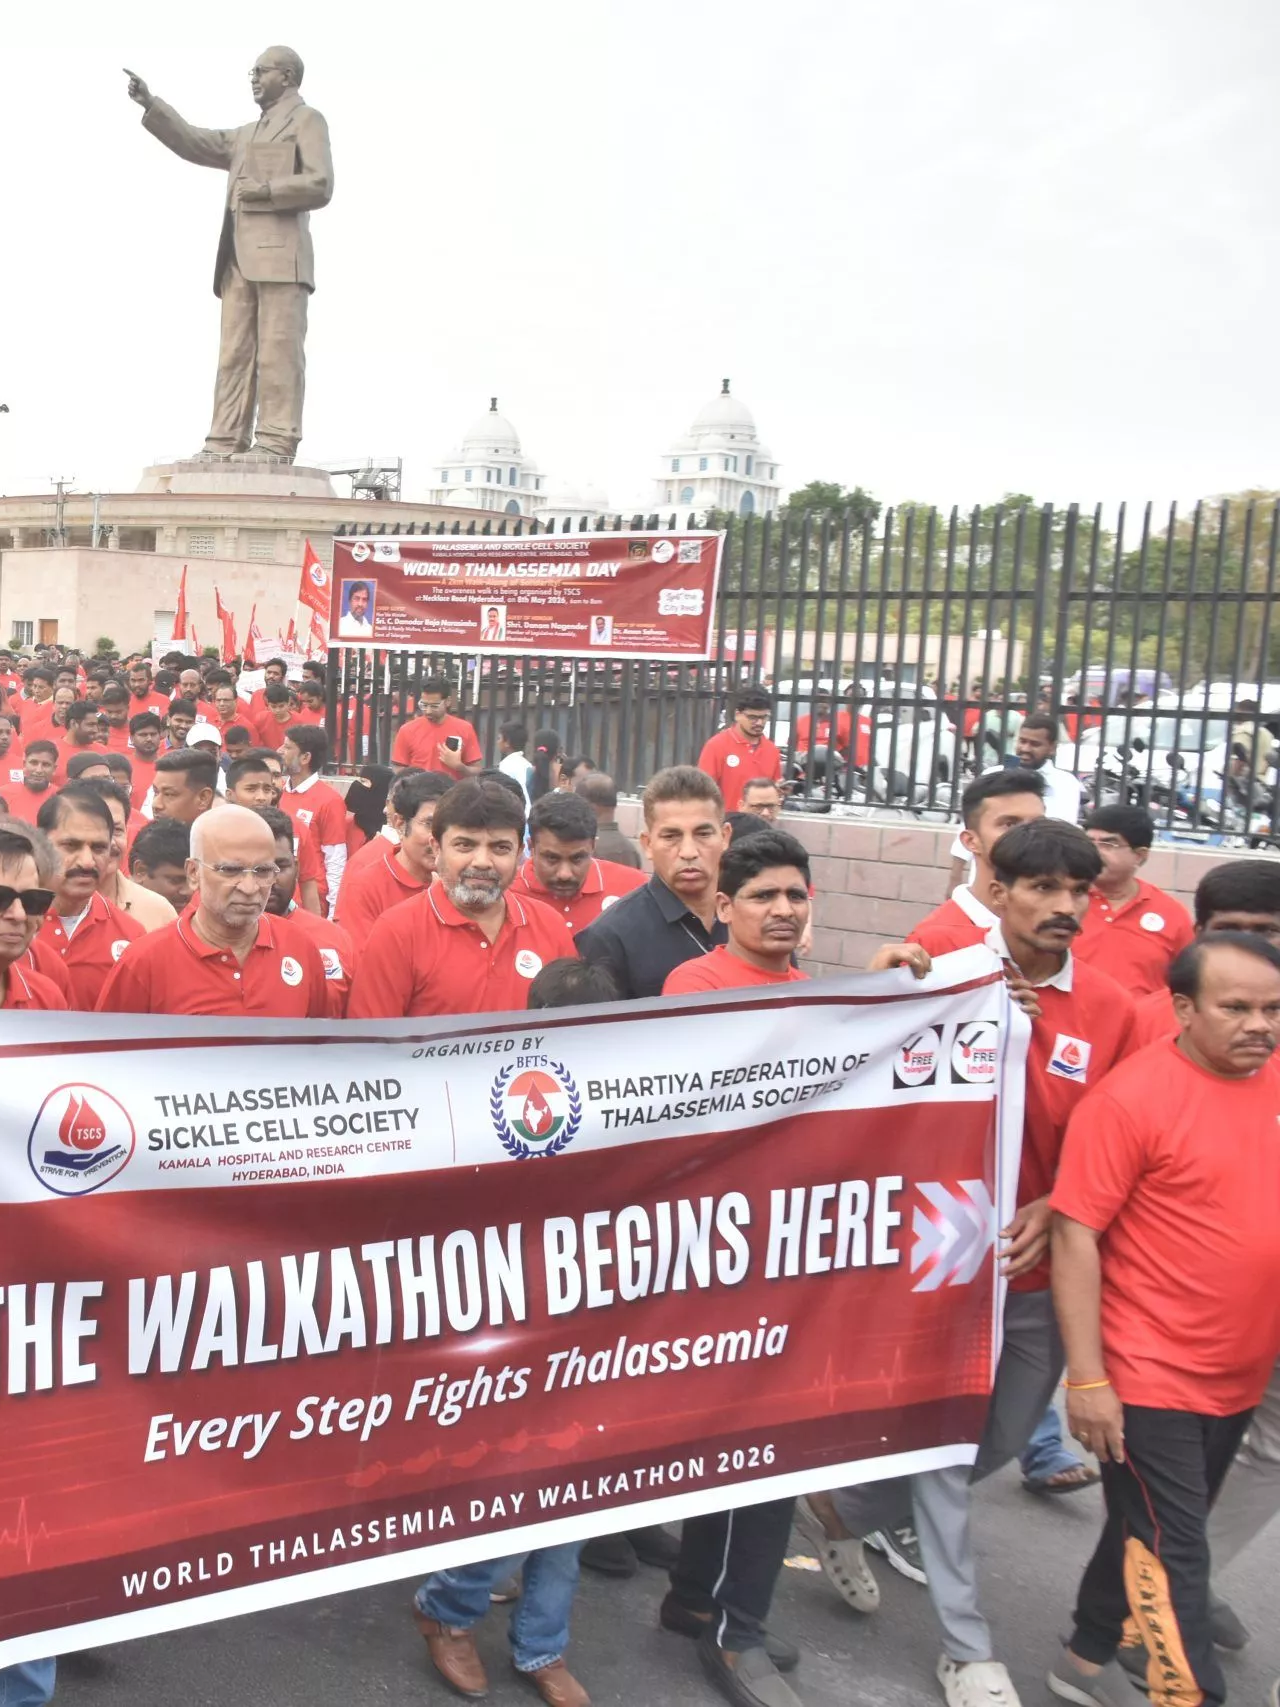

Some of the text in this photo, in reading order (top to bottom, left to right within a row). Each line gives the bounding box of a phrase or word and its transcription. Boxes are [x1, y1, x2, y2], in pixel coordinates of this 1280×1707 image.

[484, 543, 501, 551] AND
[532, 542, 553, 550] CELL
[554, 541, 591, 550] SOCIETY
[403, 563, 622, 577] WORLD THALASSEMIA DAY
[432, 586, 443, 594] The
[531, 597, 546, 605] May
[411, 1036, 545, 1059] ORGANISED BY
[973, 1052, 997, 1062] FRE
[516, 1055, 548, 1069] BFTS
[911, 1055, 933, 1066] FREE
[587, 1053, 870, 1101] BHARTIYA FEDERATION OF
[154, 1078, 402, 1118] THALASSEMIA AND
[601, 1077, 847, 1129] THALASSEMIA SOCIETIES
[76, 1127, 102, 1141] TSCS
[148, 1108, 419, 1152] SICKLE CELL SOCIETY
[39, 1147, 128, 1178] STRIVE FOR PREVENTION
[158, 1139, 412, 1170] KAMALA HOSPITAL AND RESEARCH CENTRE
[232, 1163, 345, 1182] HYDERABAD, INDIA
[128, 1222, 526, 1377] WALKATHON
[542, 1191, 751, 1316] BEGINS
[764, 1175, 903, 1279] HERE
[144, 1317, 789, 1463] Every Step Fights Thalassemia
[122, 1444, 778, 1599] WORLD THALASSEMIA DAY WALKATHON 2026
